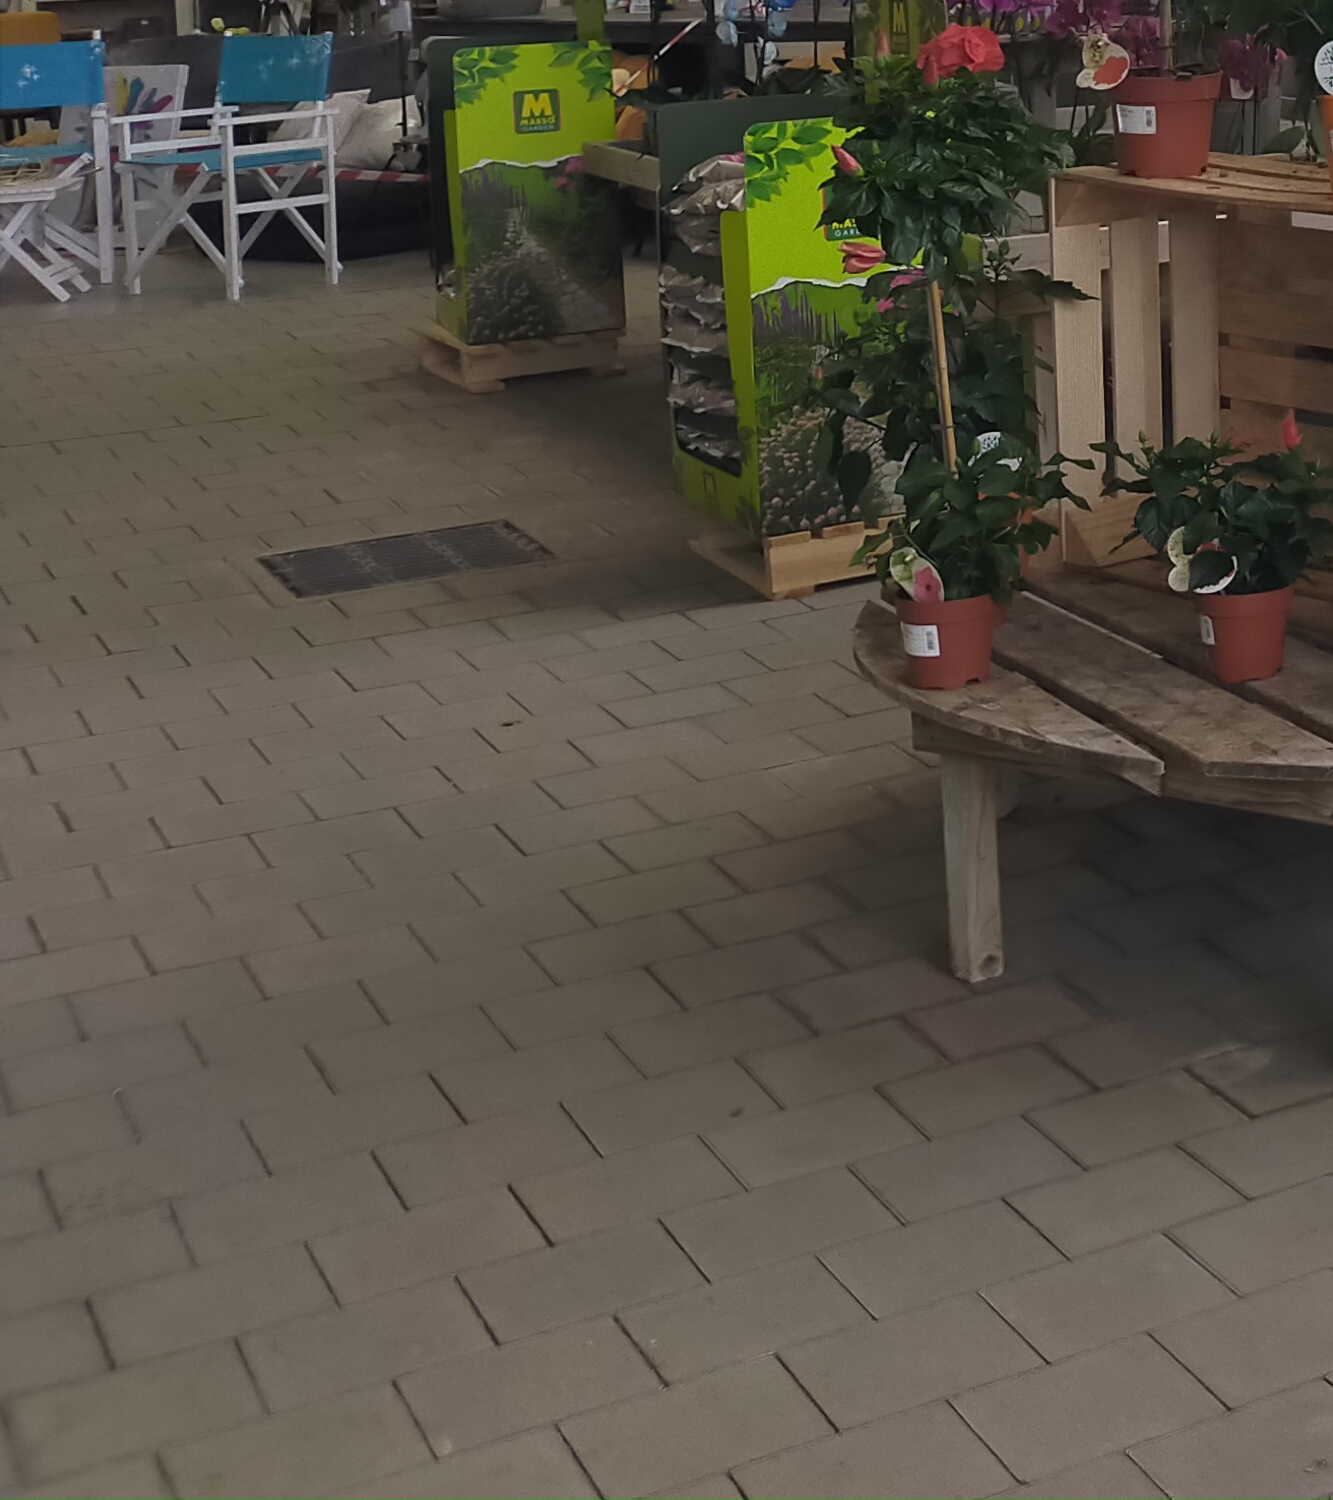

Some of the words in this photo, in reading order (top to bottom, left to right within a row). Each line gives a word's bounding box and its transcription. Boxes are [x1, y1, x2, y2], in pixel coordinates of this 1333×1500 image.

[892, 1, 907, 33] M
[521, 92, 553, 118] M
[522, 124, 554, 132] GARDEN
